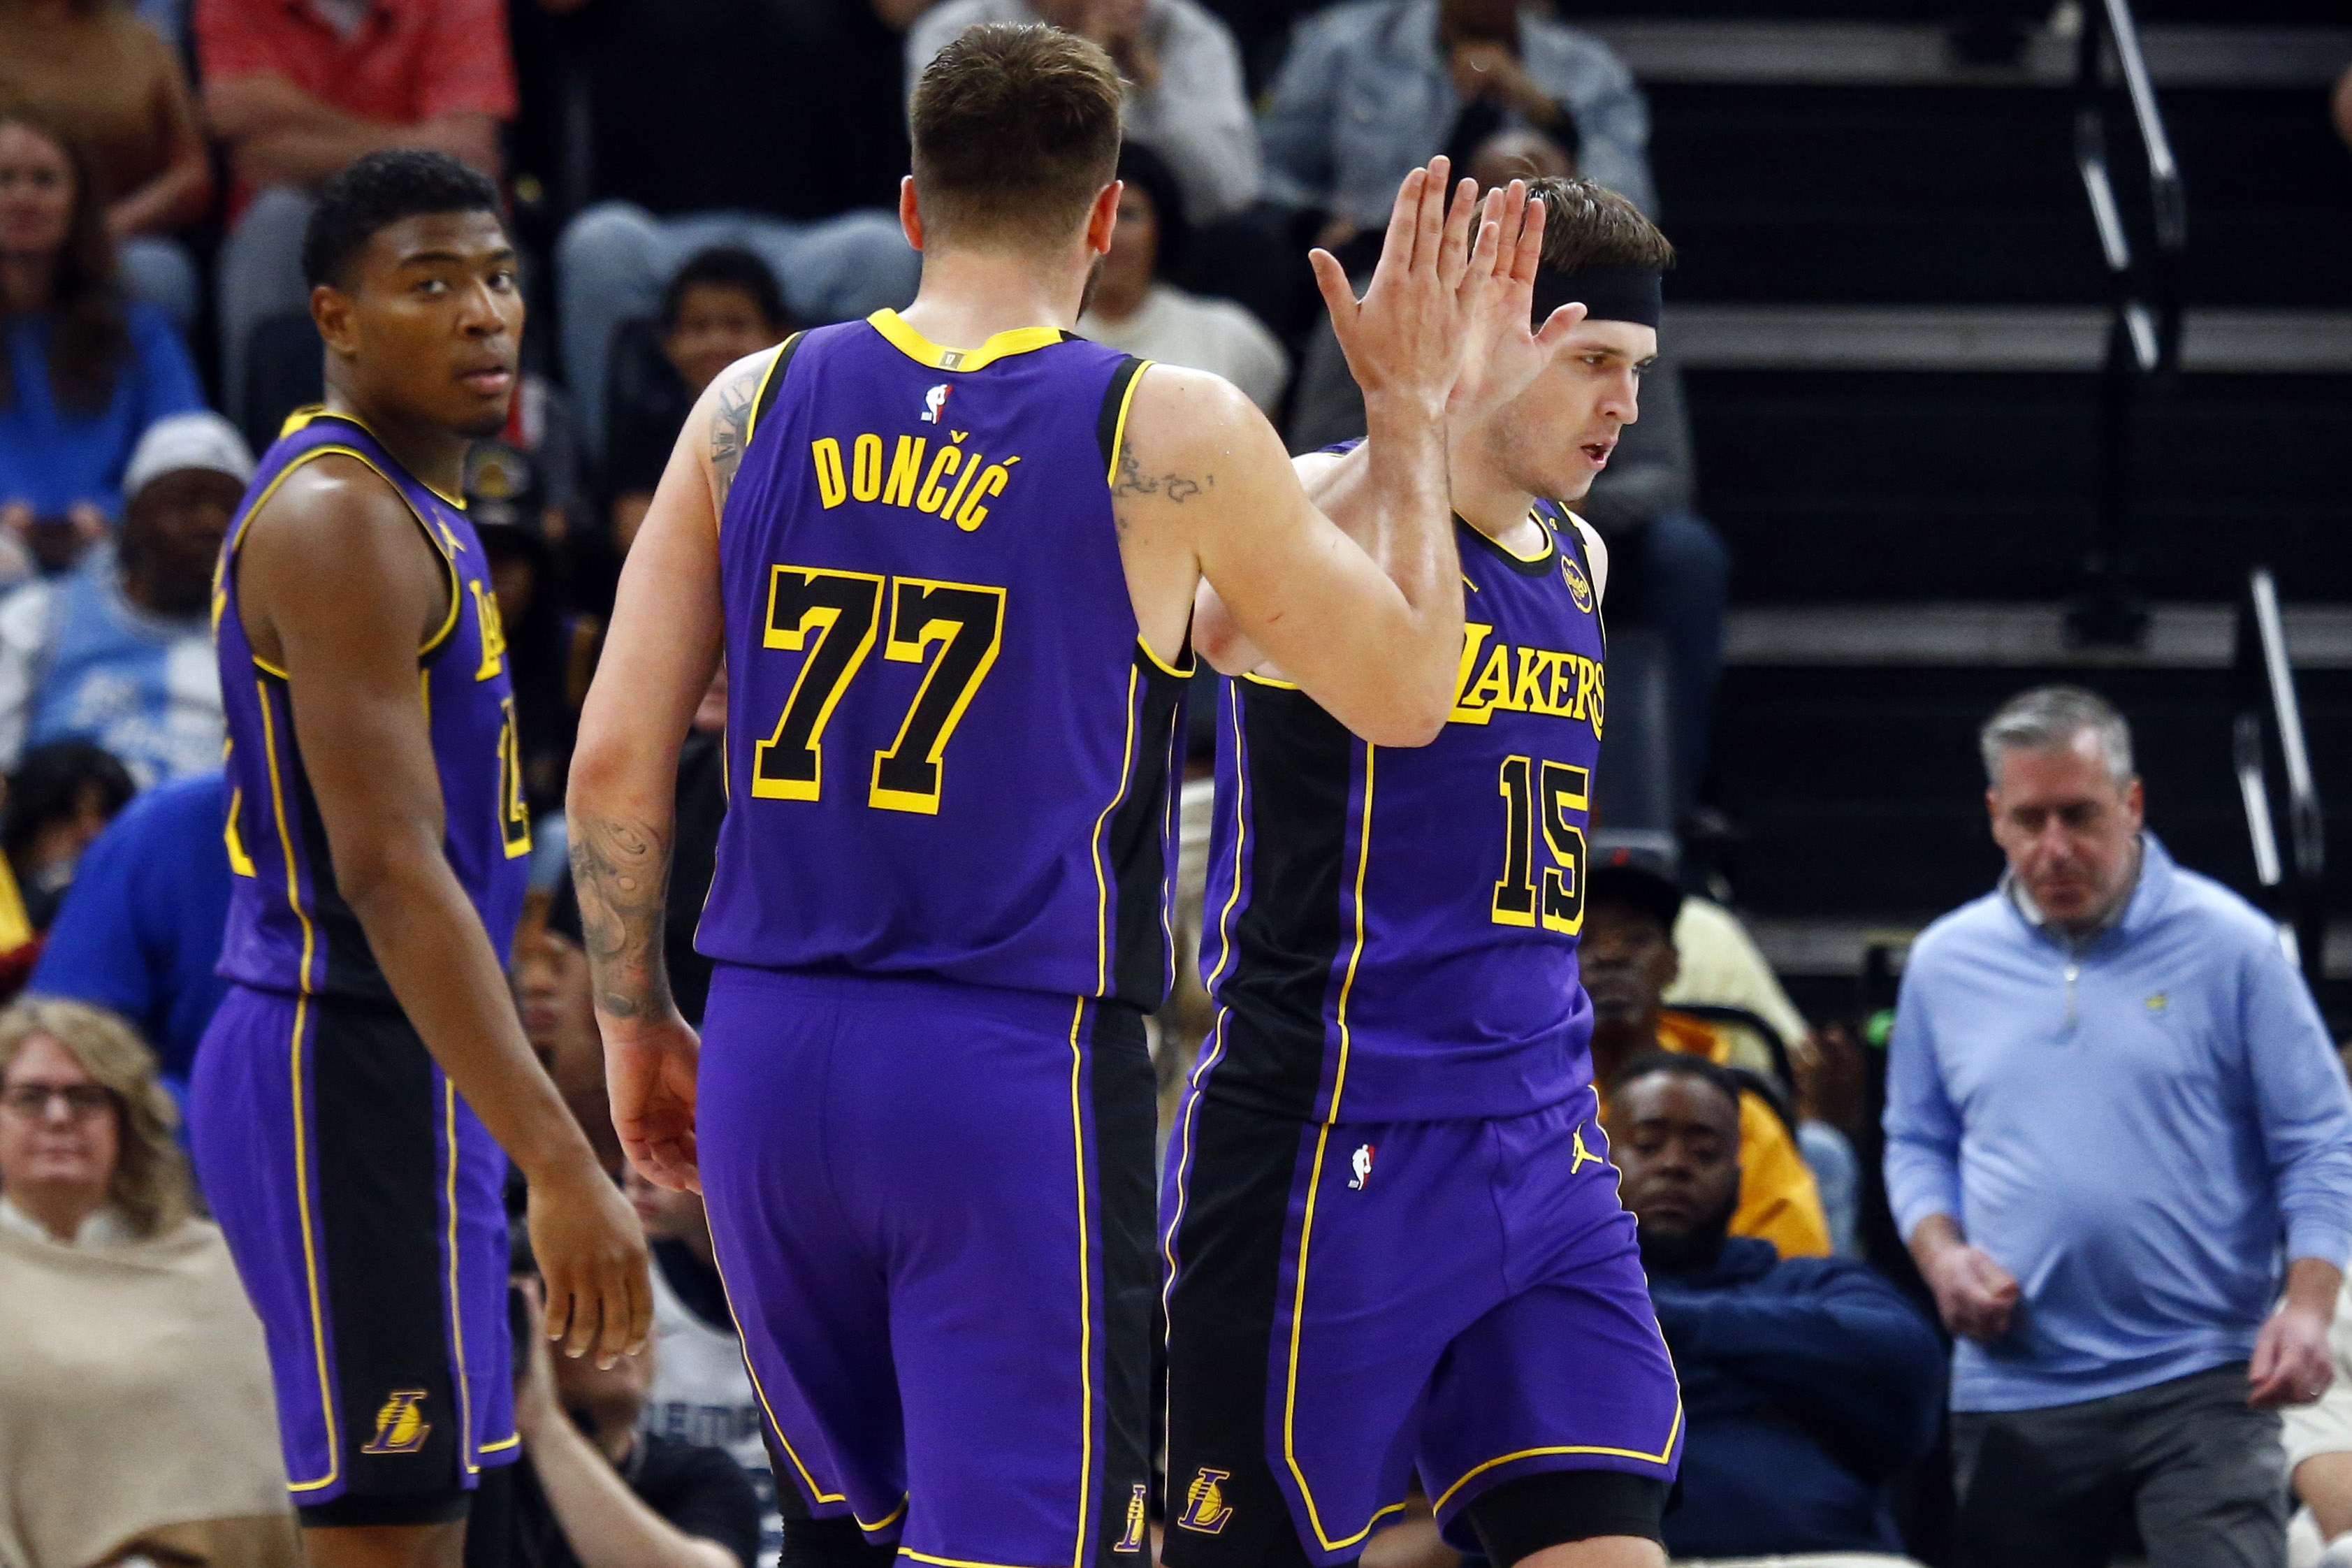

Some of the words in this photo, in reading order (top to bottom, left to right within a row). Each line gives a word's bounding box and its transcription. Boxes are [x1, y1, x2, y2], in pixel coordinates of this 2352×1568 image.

[811, 429, 1021, 532] DONČIĆ
[751, 564, 1007, 815] 77
[1491, 755, 1590, 936] 15
